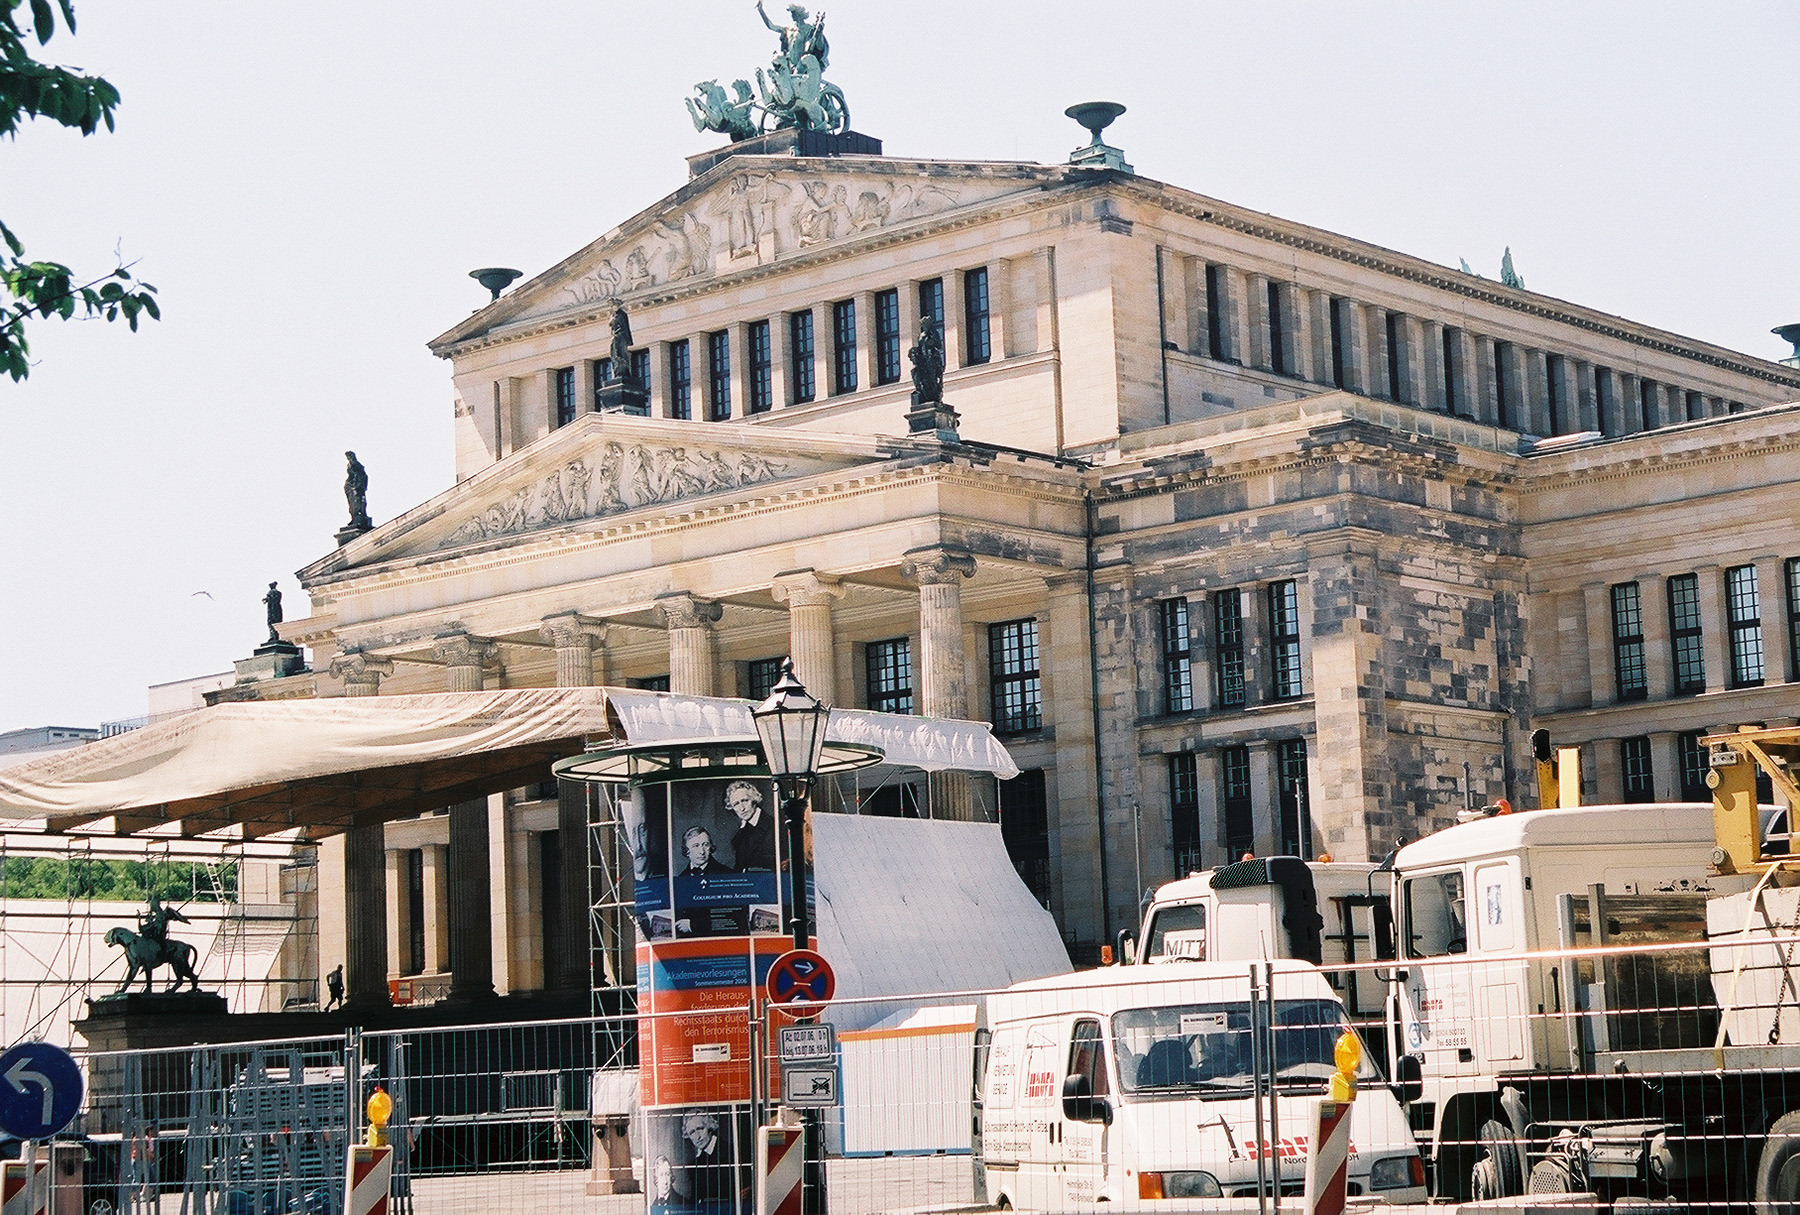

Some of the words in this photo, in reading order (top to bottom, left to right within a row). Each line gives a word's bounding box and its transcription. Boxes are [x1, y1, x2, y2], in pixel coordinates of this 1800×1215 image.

[666, 968, 747, 981] Akademievorlesungen
[700, 991, 714, 1002] Die
[716, 991, 748, 1001] Heraus-
[673, 1014, 723, 1026] Rechtsstaats
[725, 1012, 748, 1023] durch
[684, 1028, 699, 1037] den
[702, 1025, 749, 1036] Terrorismus
